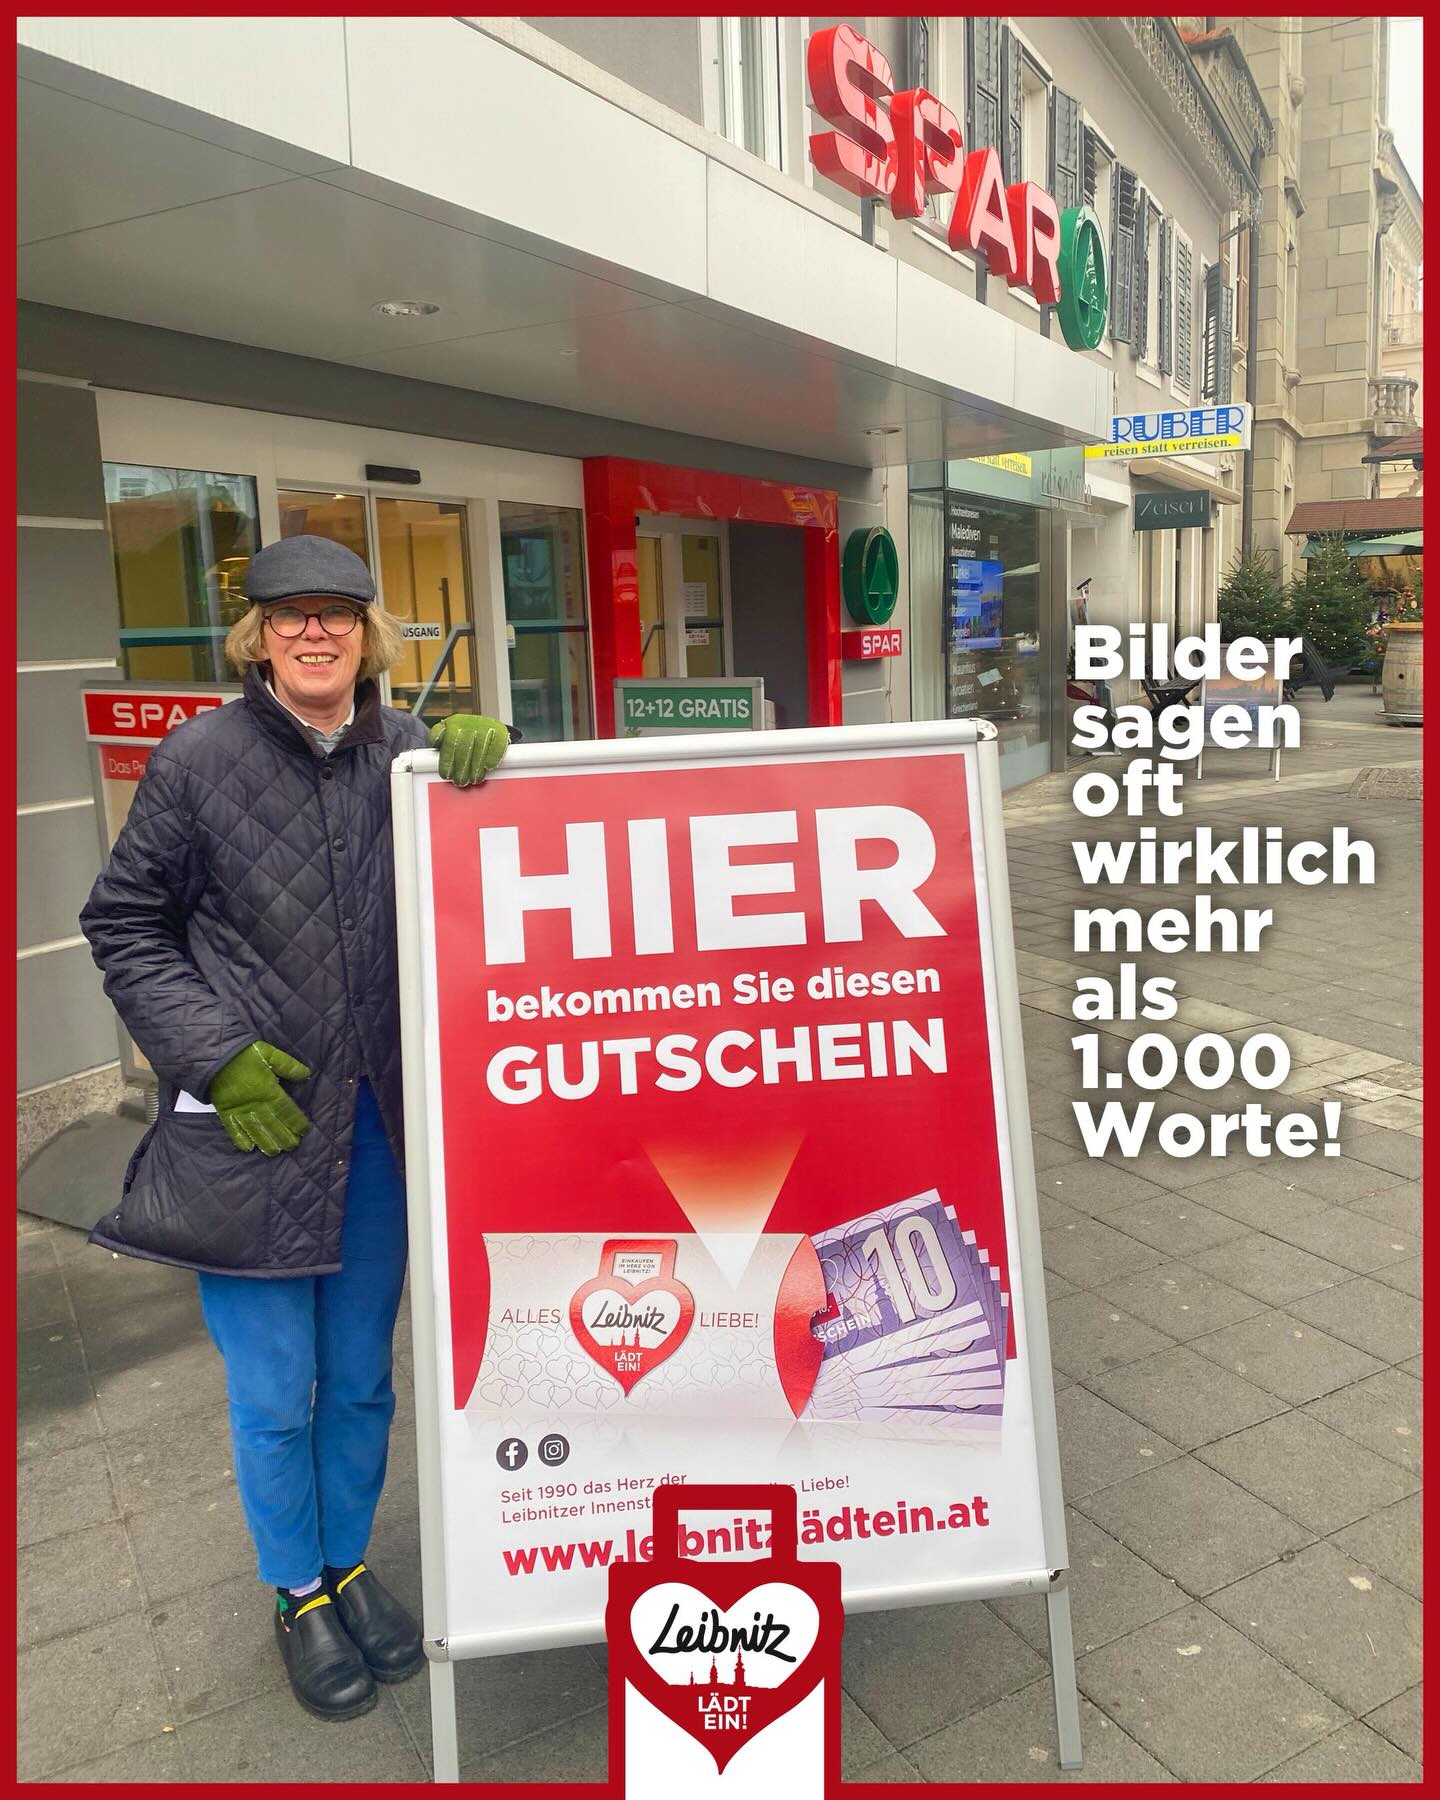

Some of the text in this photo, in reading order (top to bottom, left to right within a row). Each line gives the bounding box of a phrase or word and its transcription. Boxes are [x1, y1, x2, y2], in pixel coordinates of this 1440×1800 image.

[807, 24, 1061, 304] SPAR
[1109, 407, 1244, 444] RUBER
[1104, 438, 1231, 457] reisen statt verreisen.
[951, 523, 981, 540] Malediven
[402, 626, 440, 638] USGANG
[862, 633, 901, 655] SPAR
[626, 699, 750, 719] 12+12 GRATIS
[108, 758, 132, 775] Das
[478, 805, 948, 965] HIER
[487, 966, 940, 1023] bekommen Sie diesen
[486, 1017, 948, 1105] GUTSCHEIN
[861, 1215, 957, 1324] 10
[501, 1309, 561, 1324] ALLES
[590, 1300, 668, 1335] Leibnitz
[700, 1312, 759, 1328] LIEBE!
[811, 1312, 872, 1343] SCHEIN
[614, 1350, 643, 1362] LÄDT
[617, 1362, 641, 1372] EIN!
[501, 1473, 688, 1504] Seit 1990 das Herz der
[502, 1476, 850, 1523] Leibnitzer Innenst Liebe!
